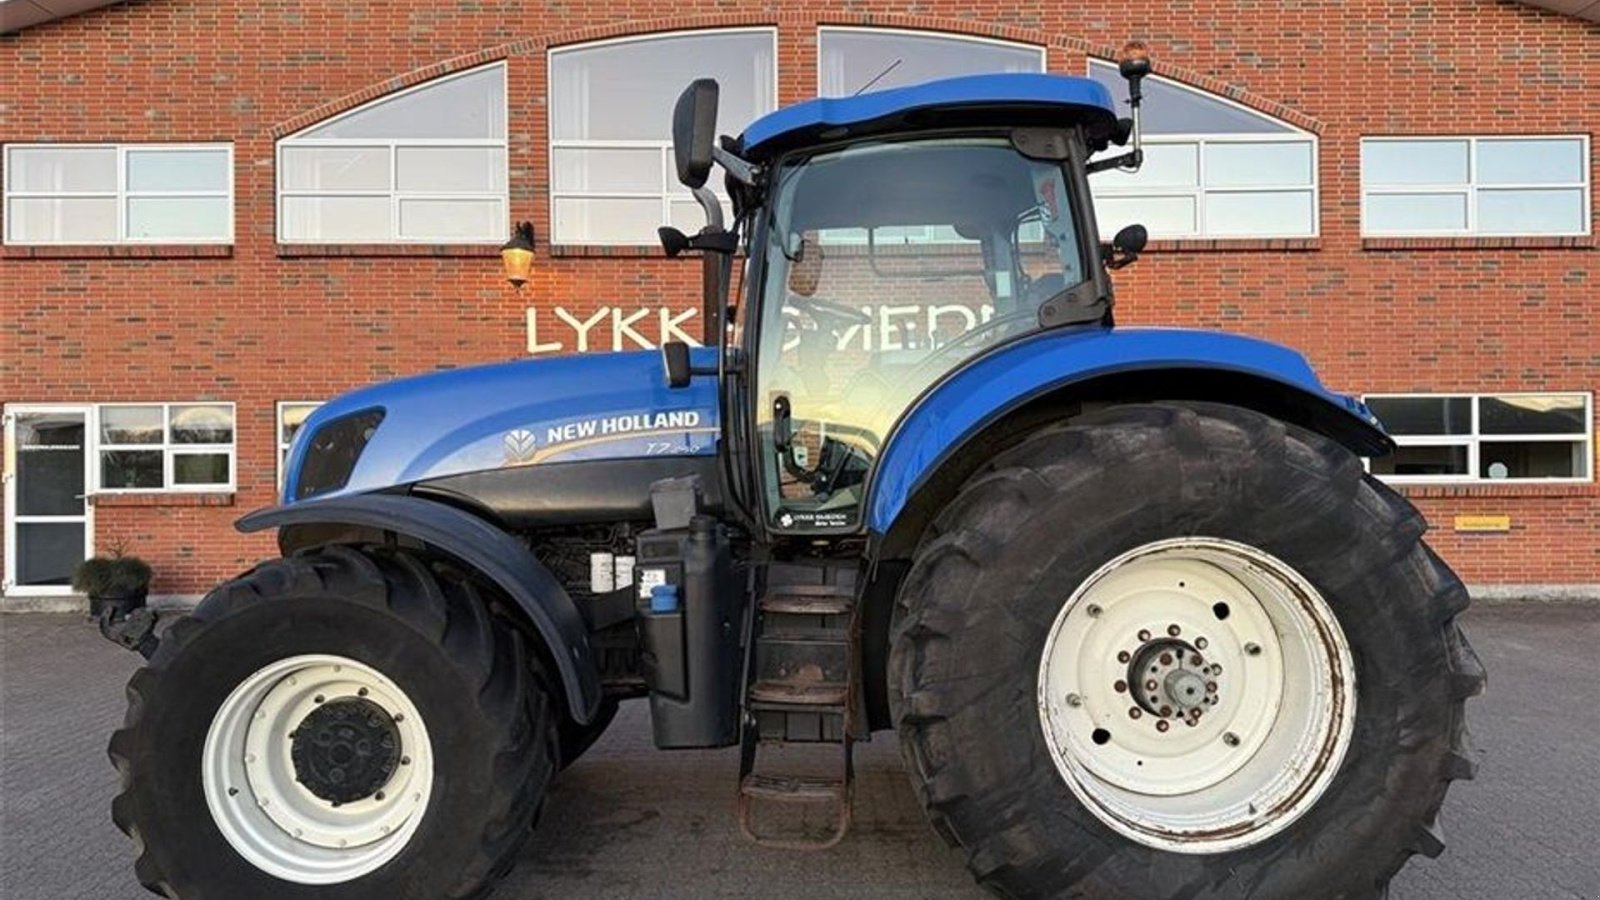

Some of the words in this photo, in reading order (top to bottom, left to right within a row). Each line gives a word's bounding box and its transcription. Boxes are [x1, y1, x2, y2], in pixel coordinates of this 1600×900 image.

[526, 305, 734, 353] LYKK
[547, 419, 598, 443] NEW
[601, 410, 700, 434] HOLLAND
